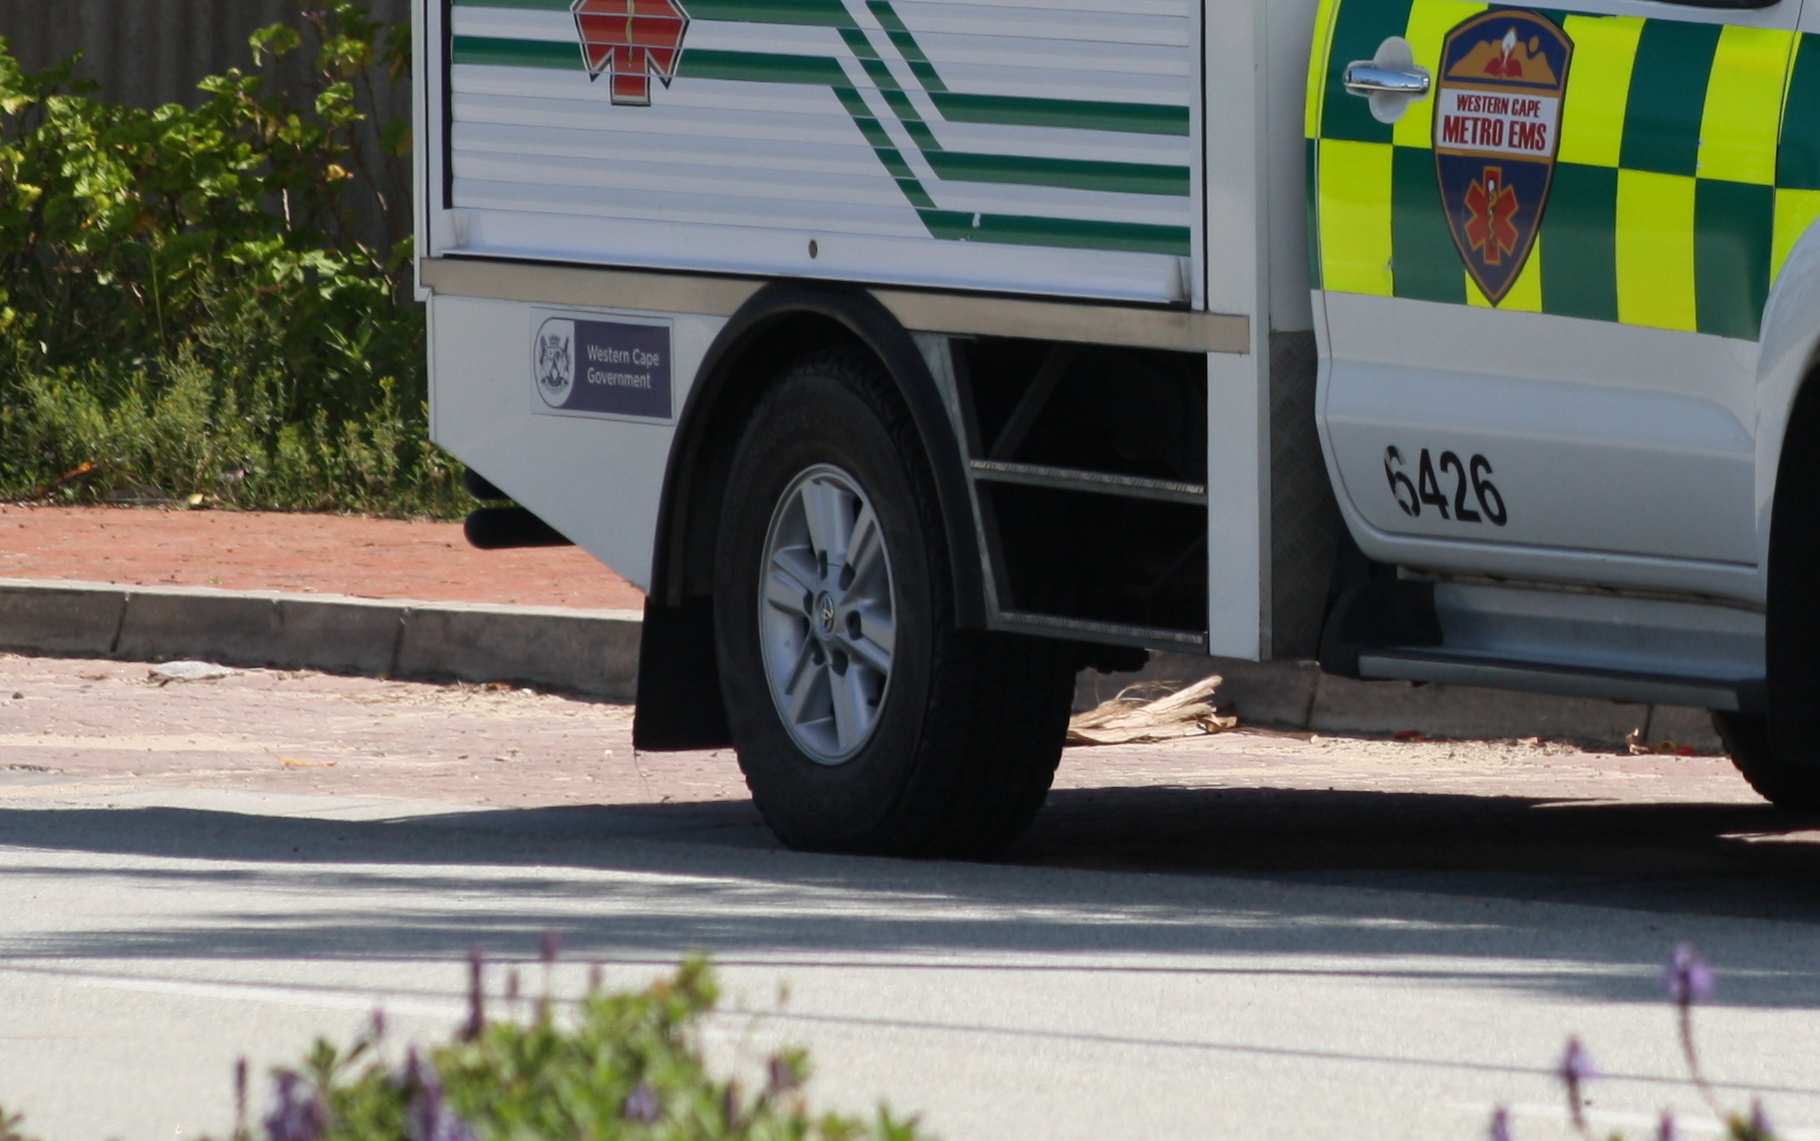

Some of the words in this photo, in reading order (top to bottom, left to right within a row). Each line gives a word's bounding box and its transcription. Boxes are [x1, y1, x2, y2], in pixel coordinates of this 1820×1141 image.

[1456, 94, 1509, 115] WESTERN
[1511, 98, 1541, 118] CAPE
[1442, 115, 1504, 147] METRO
[1508, 121, 1547, 151] EMS
[586, 344, 630, 364] Western
[632, 349, 660, 369] Cape
[587, 367, 652, 389] Government
[1384, 445, 1507, 527] 6426
